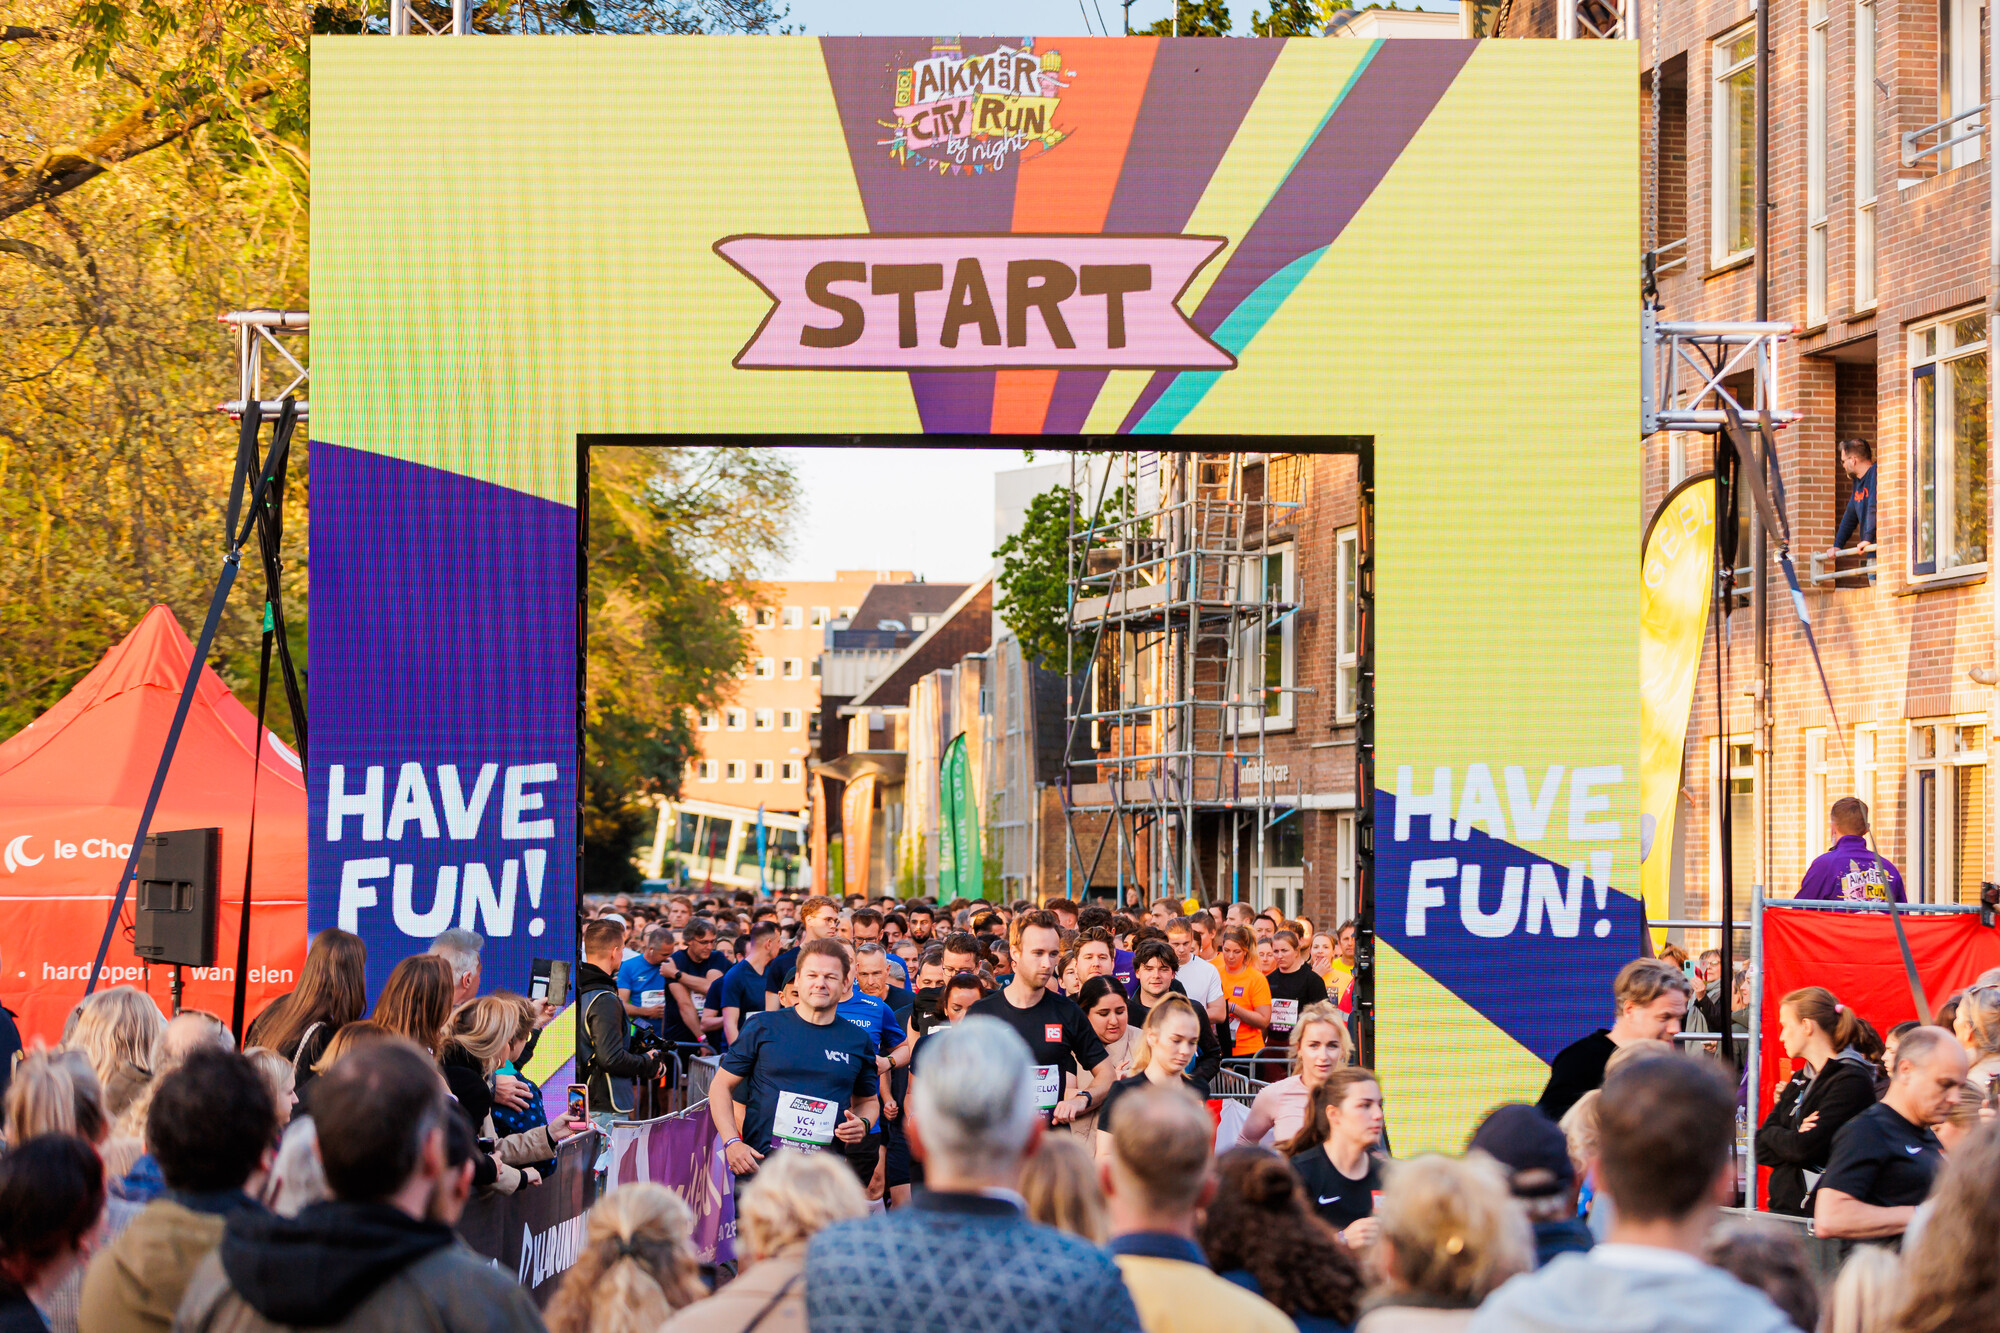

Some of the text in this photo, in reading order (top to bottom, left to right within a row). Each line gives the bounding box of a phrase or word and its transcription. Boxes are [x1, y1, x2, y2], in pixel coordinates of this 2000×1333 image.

[979, 97, 1045, 134] RUN
[946, 128, 1030, 171] by night
[799, 257, 1152, 349] START
[1644, 496, 1713, 588] GEEL
[1274, 764, 1289, 783] care
[326, 761, 558, 842] HAVE
[1393, 762, 1624, 842] HAVE
[54, 839, 78, 859] le
[337, 848, 547, 938] FUN!
[1405, 850, 1613, 938] FUN!
[42, 961, 293, 989] hardopen wanelen
[1046, 1027, 1061, 1039] RS
[824, 1049, 849, 1064] VC4
[792, 1126, 813, 1137] 7724
[797, 1115, 815, 1127] VC4
